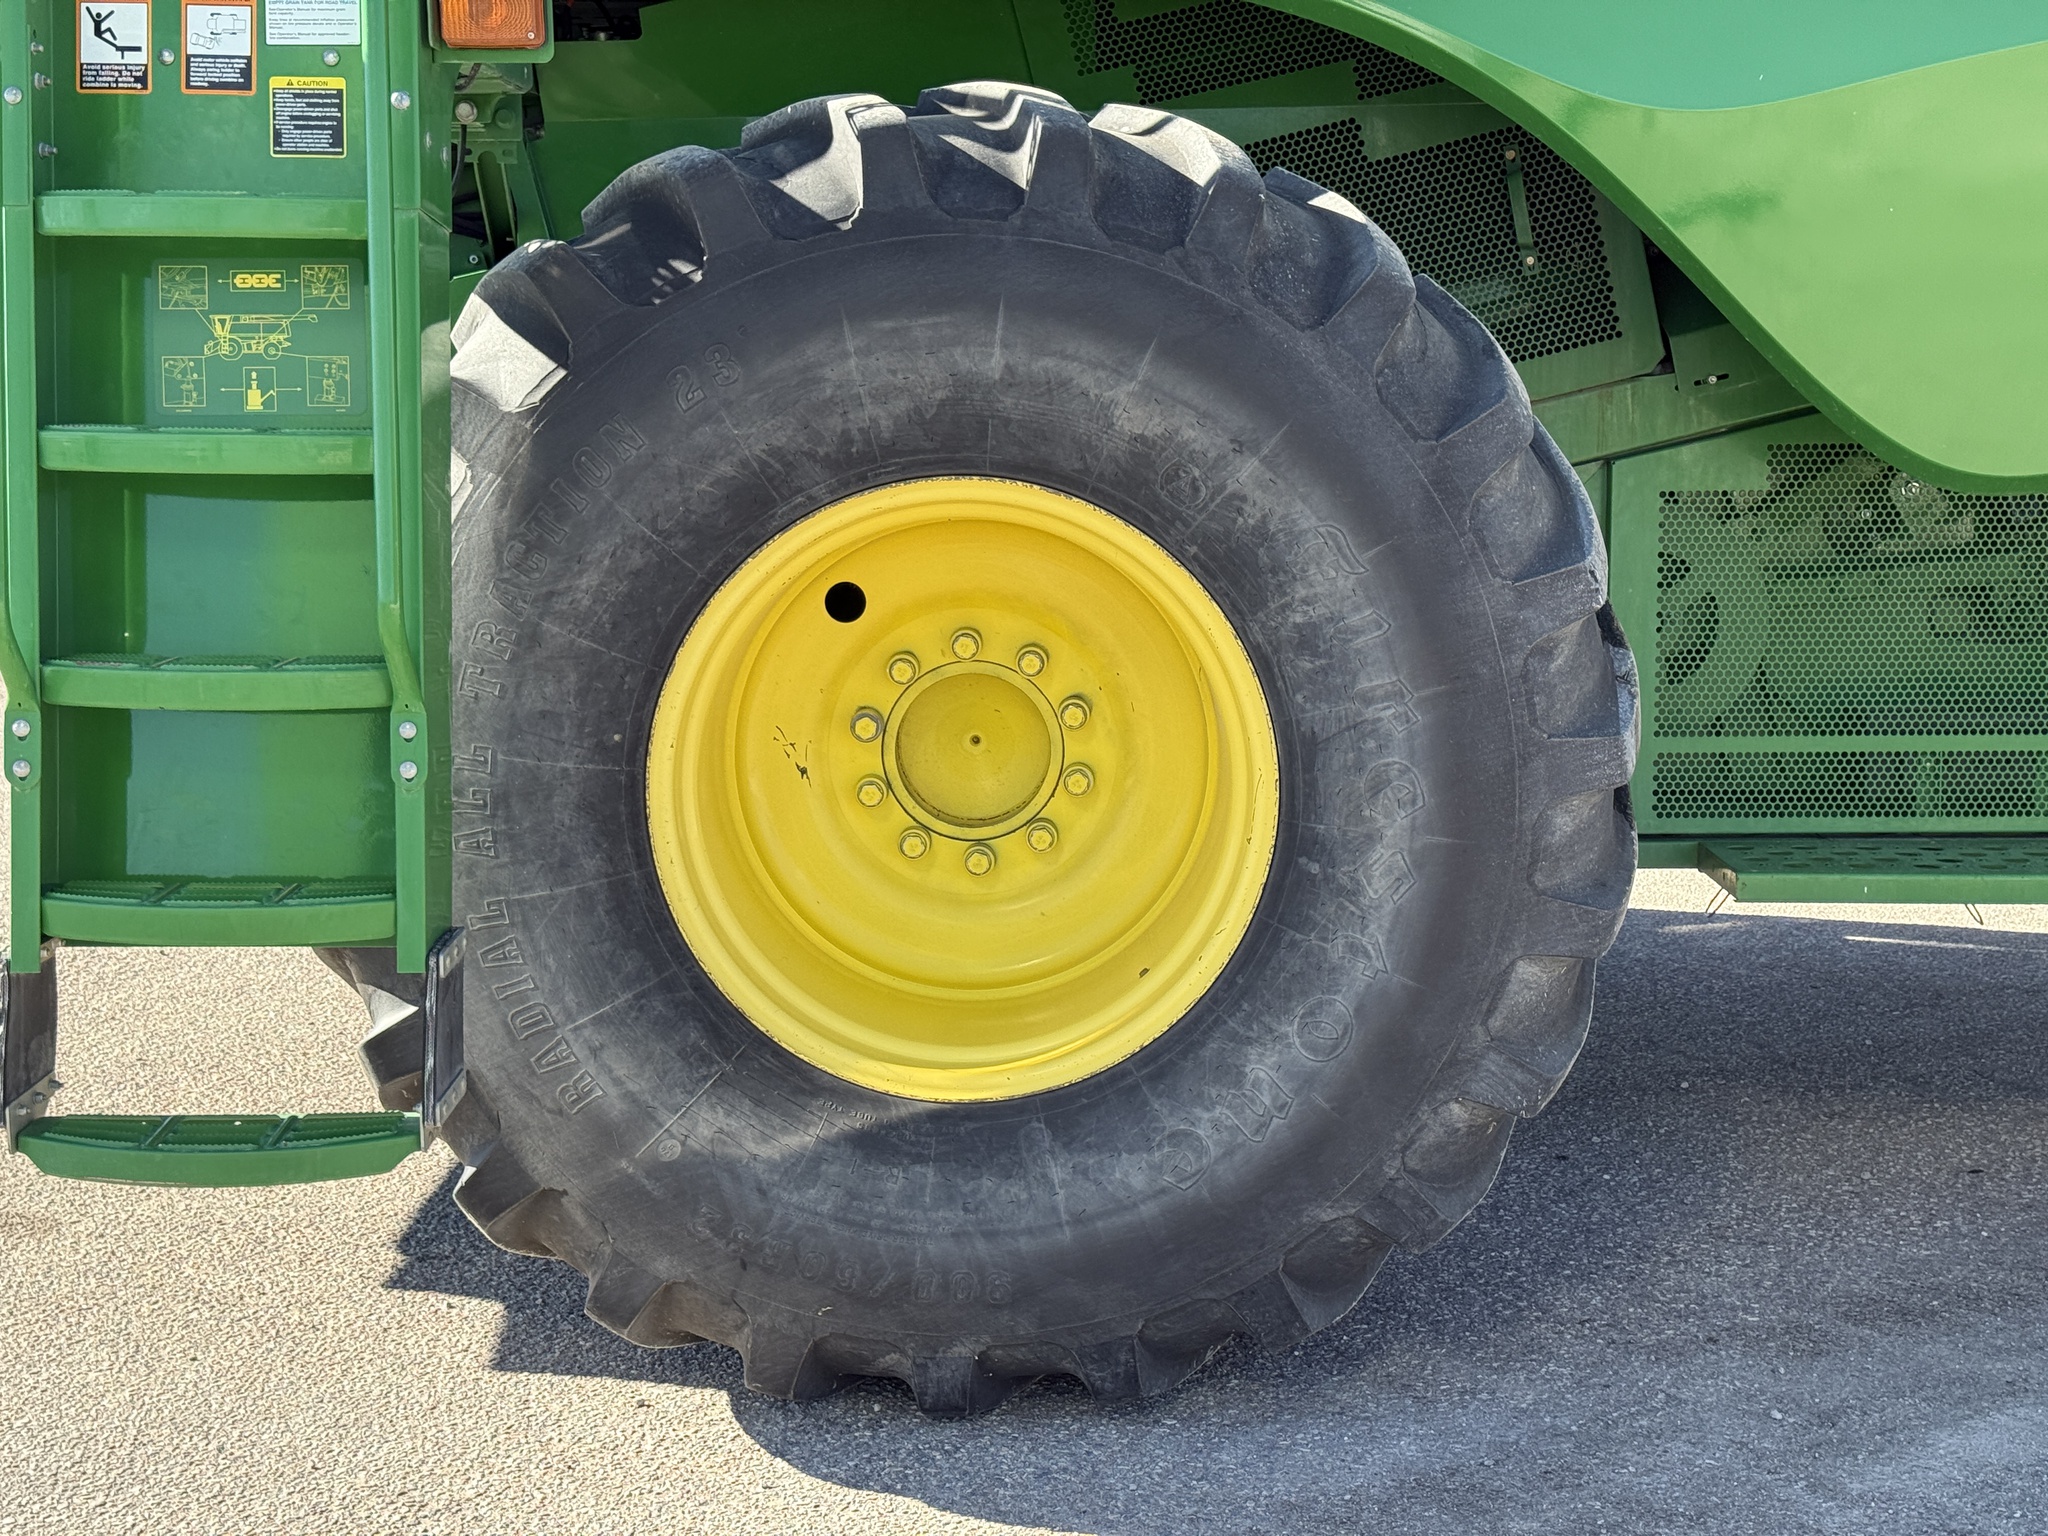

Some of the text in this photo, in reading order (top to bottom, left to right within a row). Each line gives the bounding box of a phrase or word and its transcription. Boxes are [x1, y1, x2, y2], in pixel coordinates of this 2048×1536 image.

[458, 412, 647, 699] TRACTION
[452, 744, 497, 858] ALL
[1154, 523, 1426, 1191] Firestone
[466, 896, 608, 1115] RADIAL
